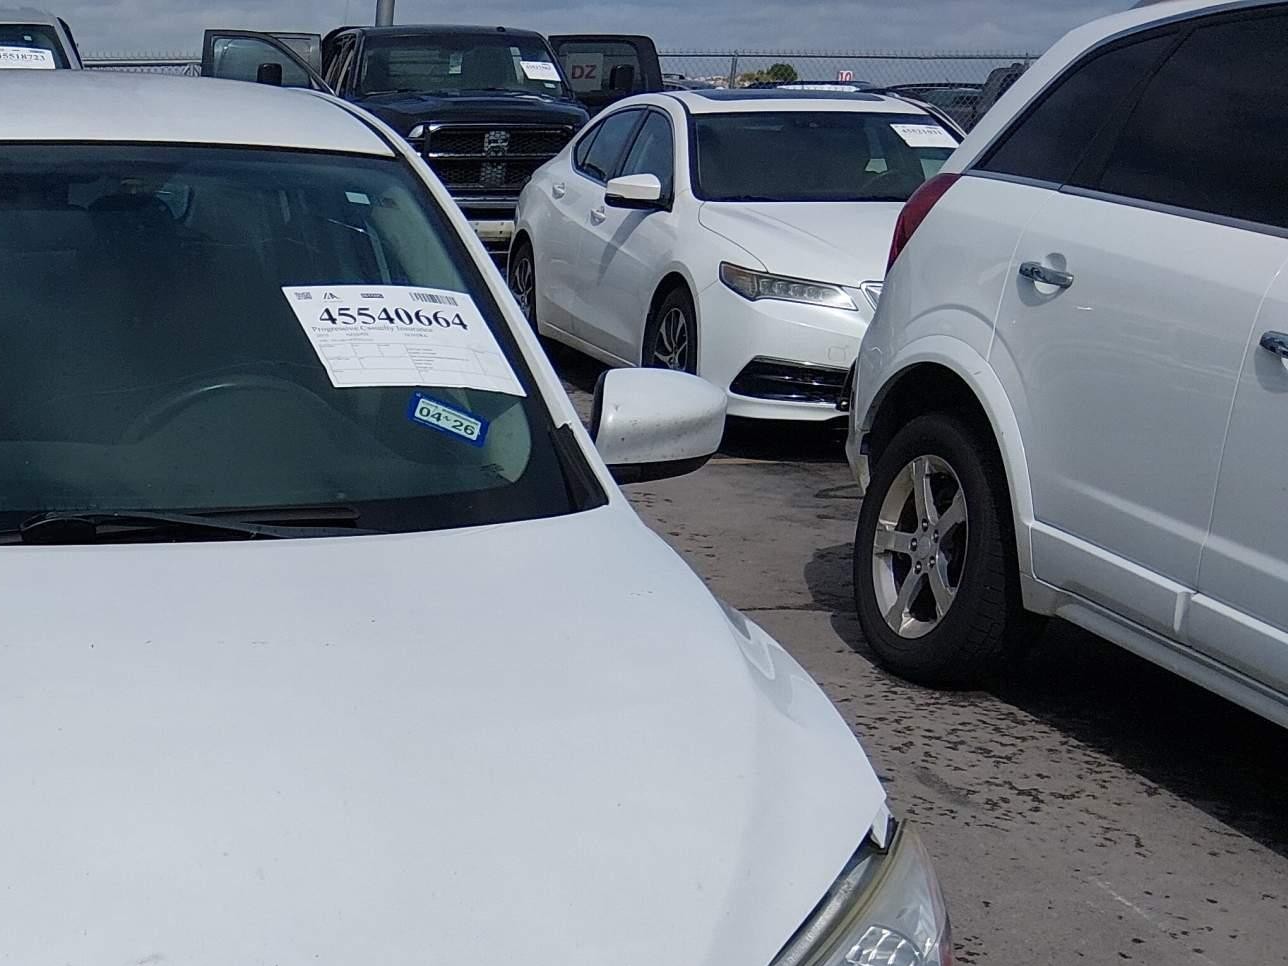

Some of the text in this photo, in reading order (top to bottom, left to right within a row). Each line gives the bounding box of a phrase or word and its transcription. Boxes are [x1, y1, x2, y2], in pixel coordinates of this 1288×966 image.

[571, 64, 597, 80] DZ
[319, 306, 469, 331] 45540664
[419, 406, 442, 422] 04
[451, 419, 476, 436] 26
